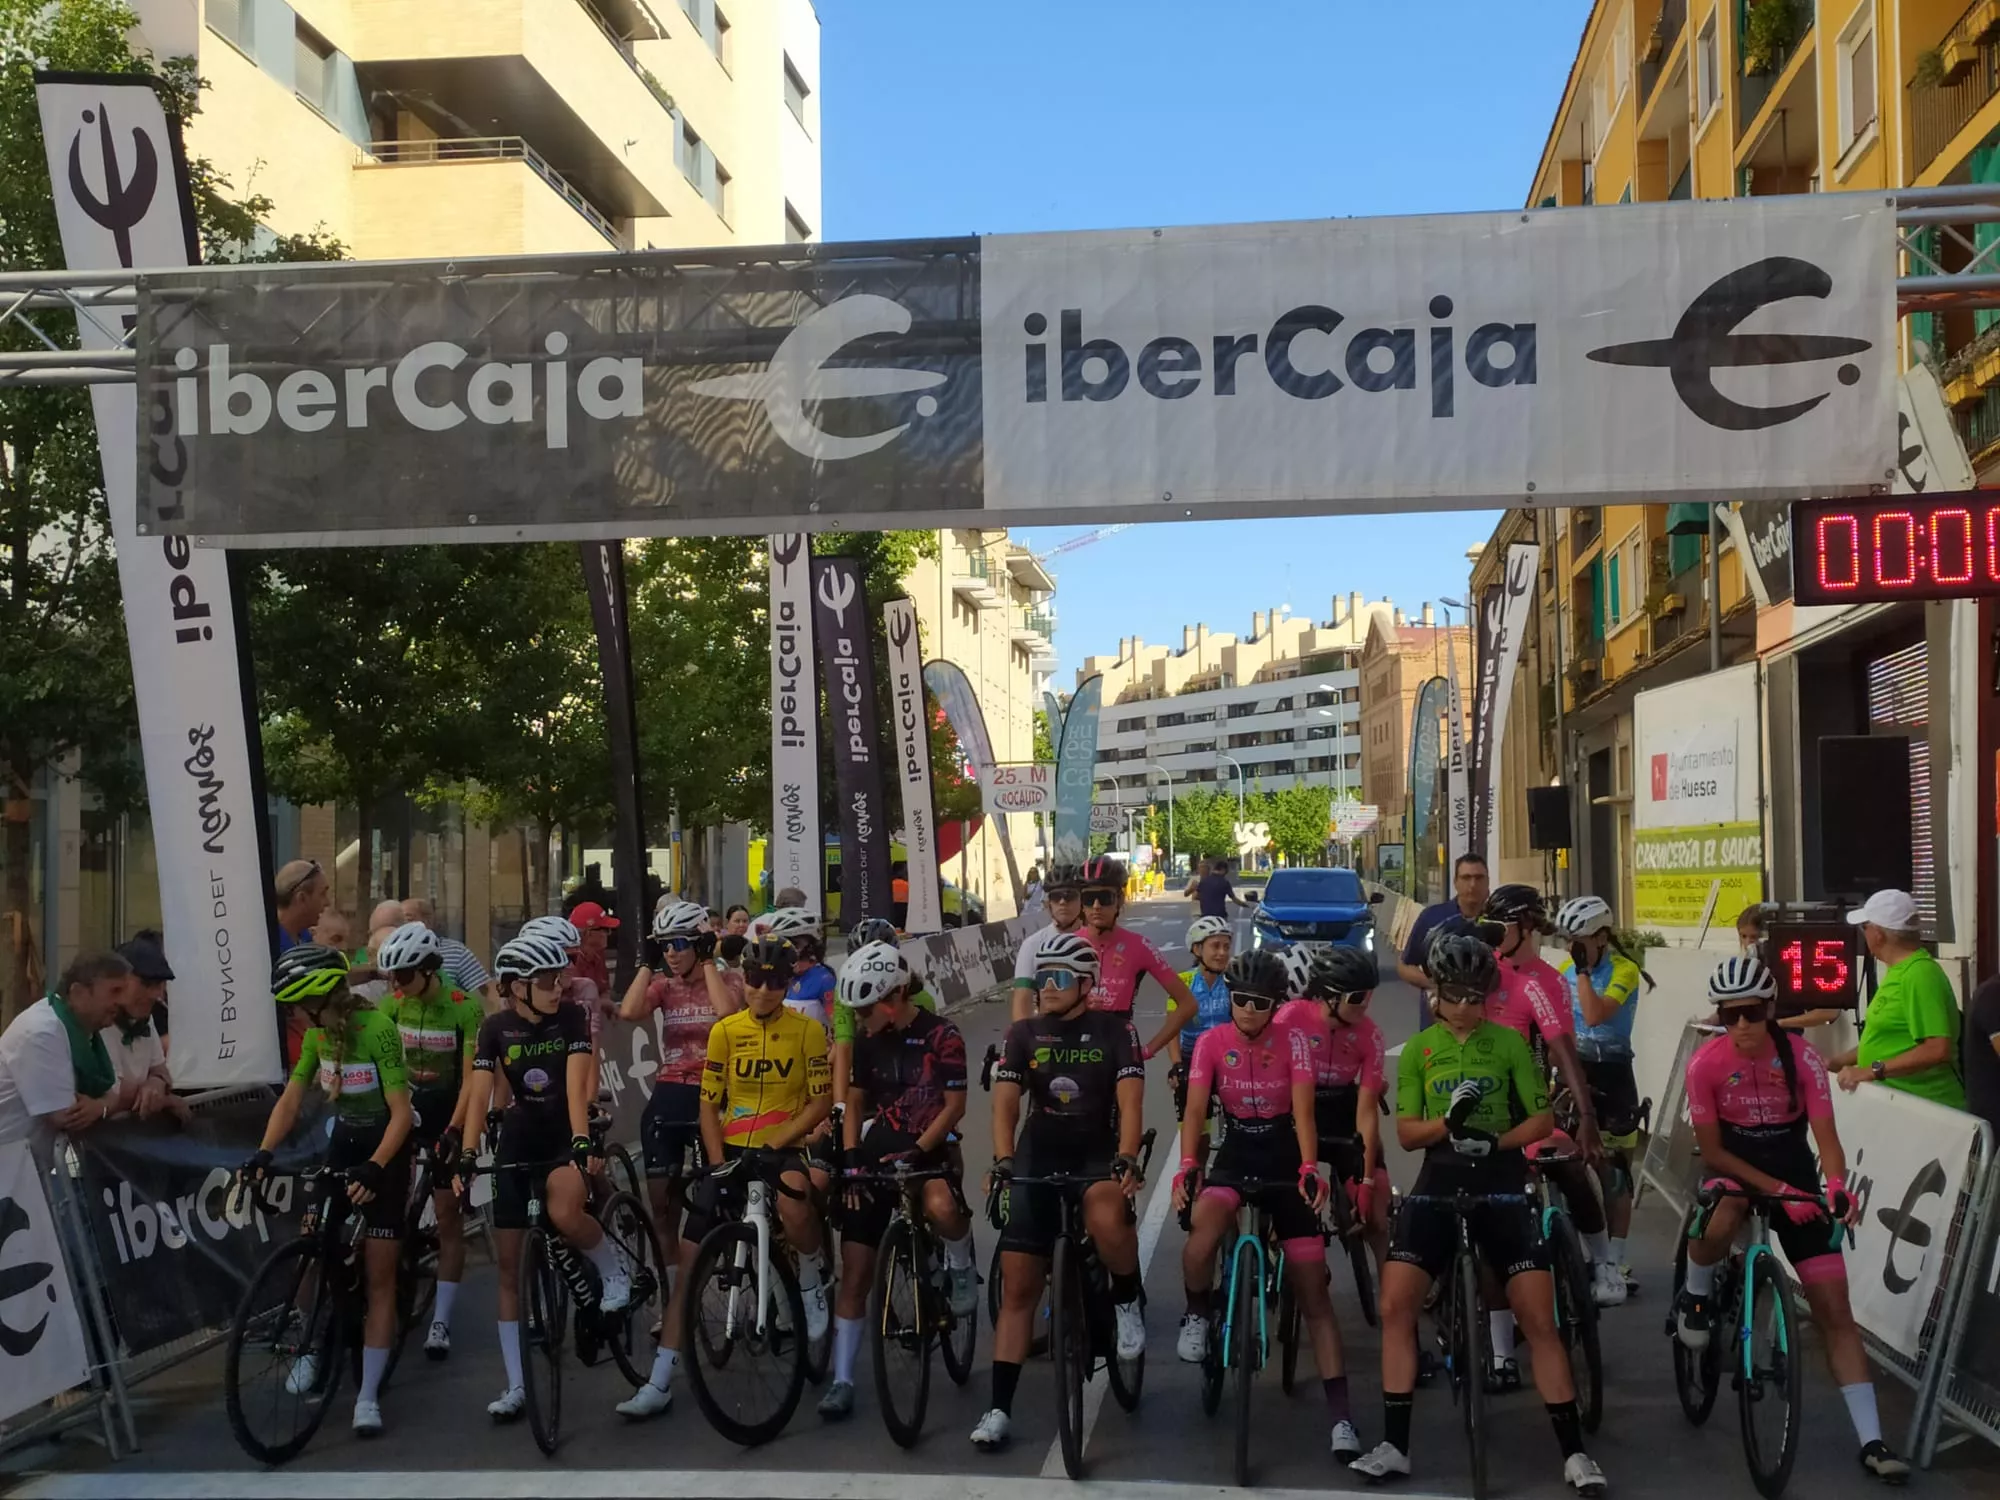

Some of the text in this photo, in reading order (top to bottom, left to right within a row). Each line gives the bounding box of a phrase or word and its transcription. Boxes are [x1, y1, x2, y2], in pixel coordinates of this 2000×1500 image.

[1024, 294, 1539, 418] iberCaja
[175, 330, 645, 450] iberCaja
[1751, 512, 1792, 569] iberCaj
[1030, 766, 1047, 784] M
[1669, 746, 1734, 775] Ayuntamiento
[1681, 778, 1718, 799] Huesca
[1703, 839, 1718, 868] EL
[1780, 940, 1848, 991] 15
[735, 1057, 794, 1079] UPV
